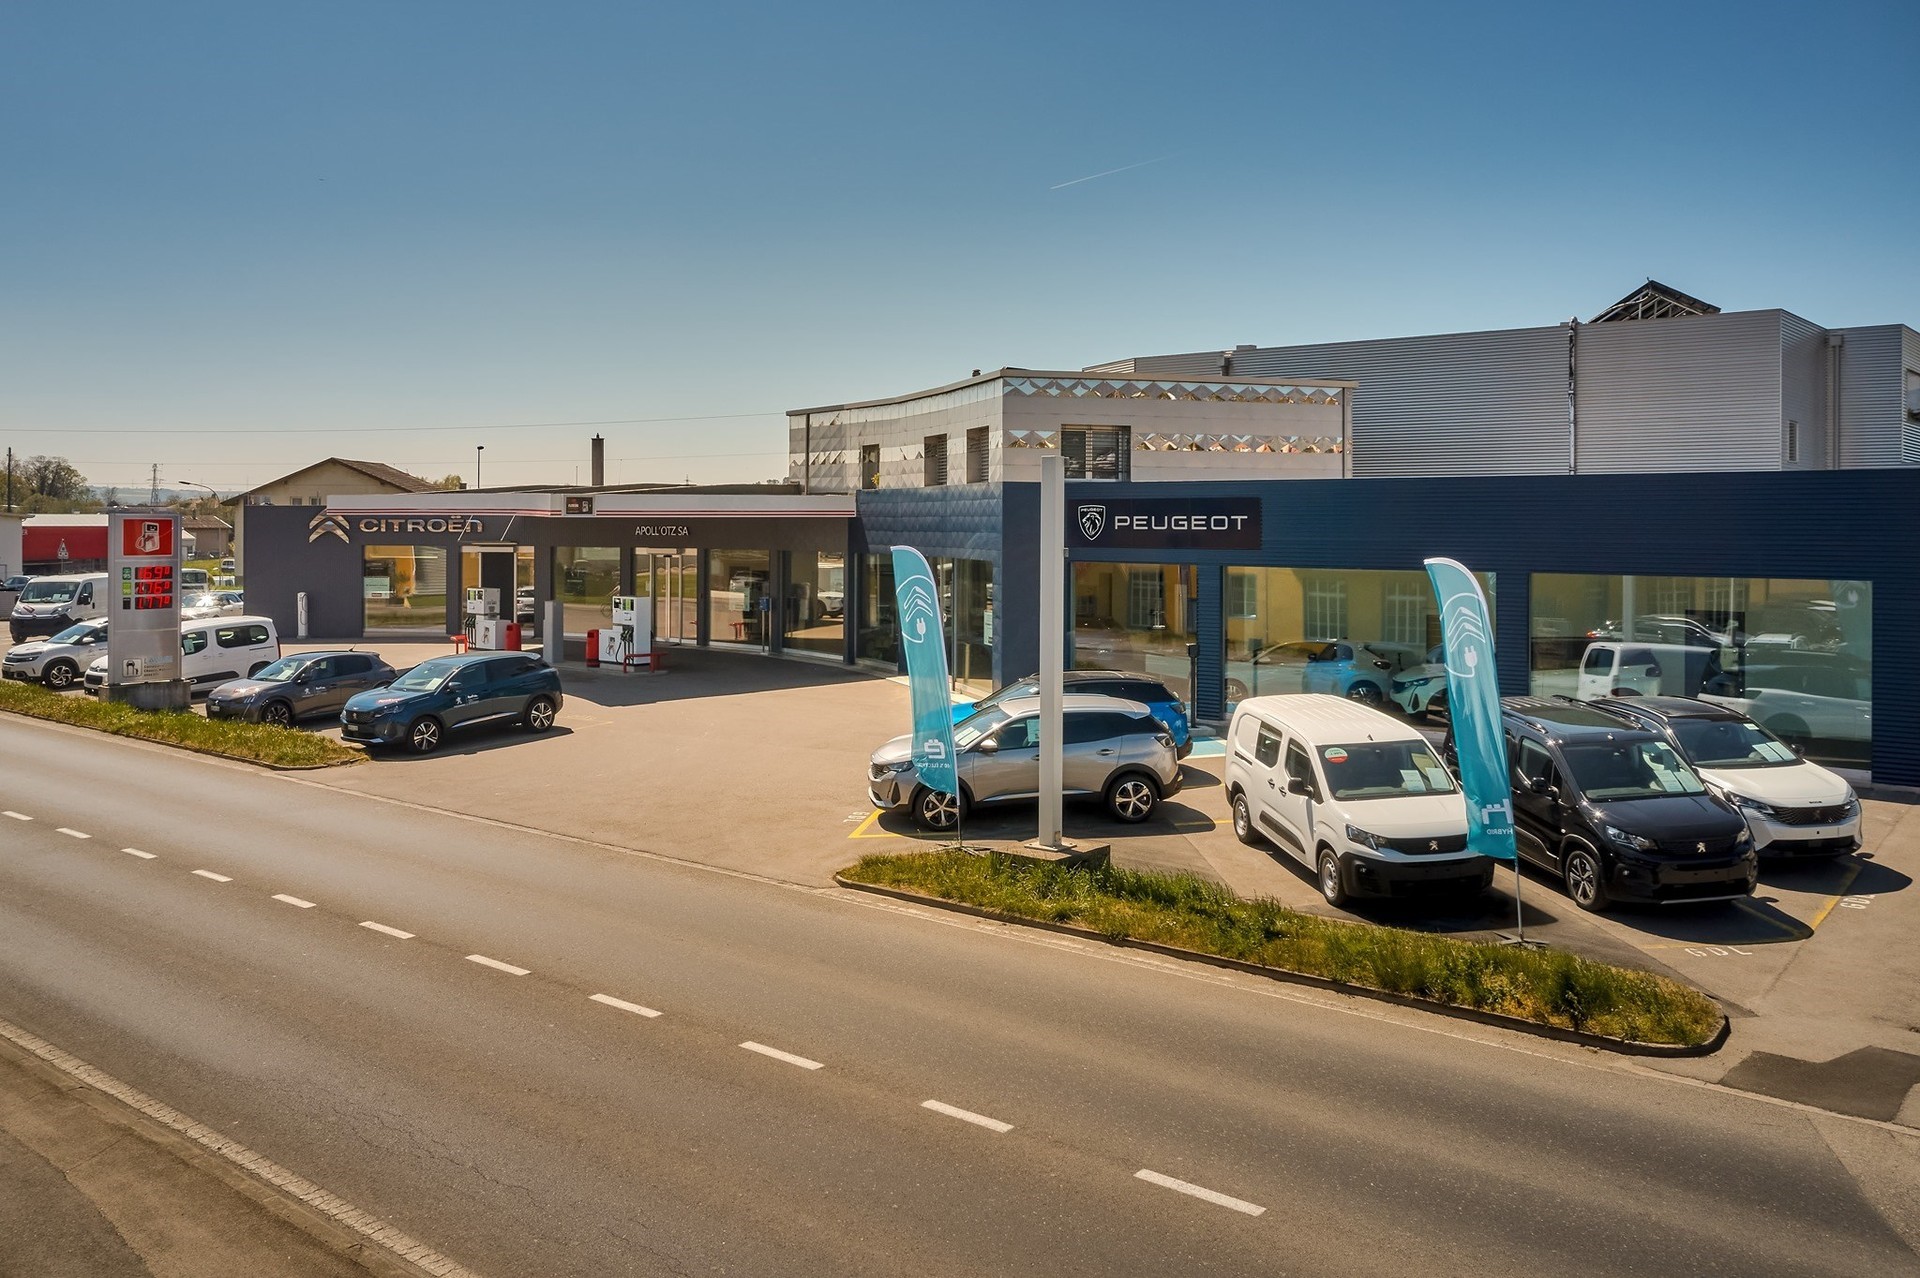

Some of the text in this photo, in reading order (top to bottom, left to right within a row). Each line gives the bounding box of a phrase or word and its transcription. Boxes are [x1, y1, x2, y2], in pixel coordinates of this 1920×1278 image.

[1114, 515, 1248, 530] PEUGEOT
[634, 525, 689, 536] APOLL'OTZ SA
